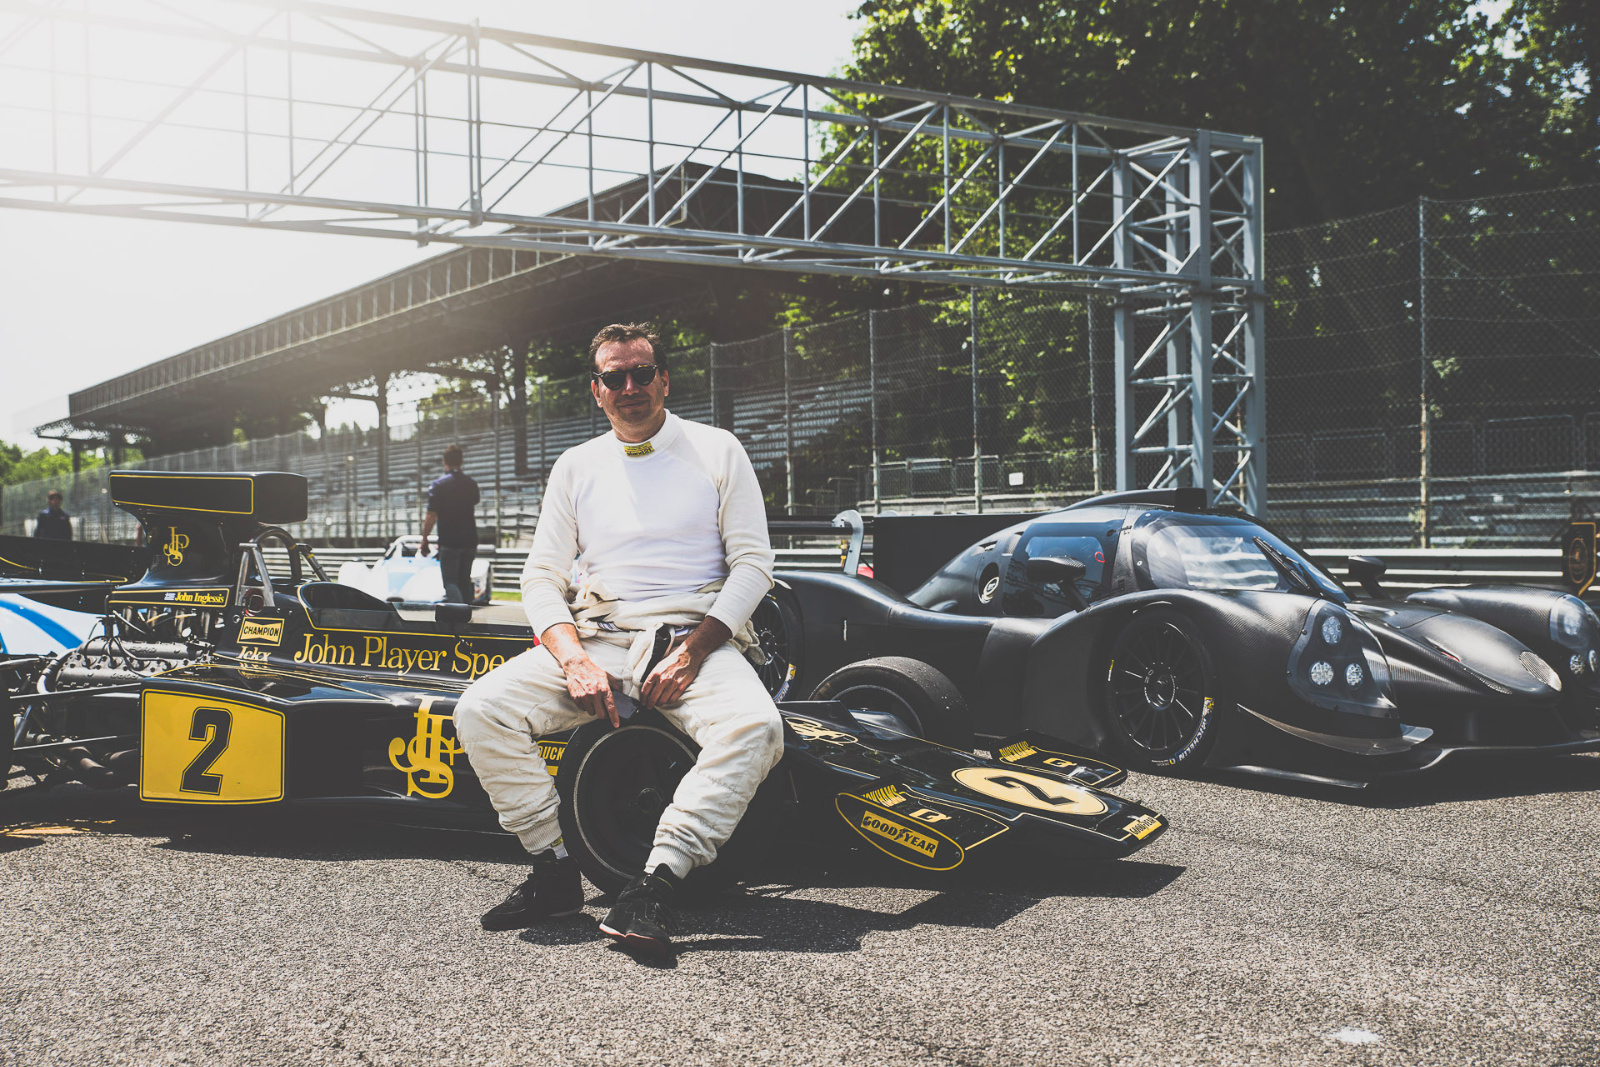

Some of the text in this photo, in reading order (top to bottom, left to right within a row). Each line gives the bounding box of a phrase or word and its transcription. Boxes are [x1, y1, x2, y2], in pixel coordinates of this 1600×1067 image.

[175, 592, 194, 602] John
[243, 626, 280, 637] CHAMPION
[236, 645, 272, 662] Ickx
[294, 633, 356, 666] John
[361, 636, 447, 676] Player
[179, 706, 234, 796] 2
[1178, 717, 1208, 762] MICHELIN
[984, 776, 1079, 806] 2
